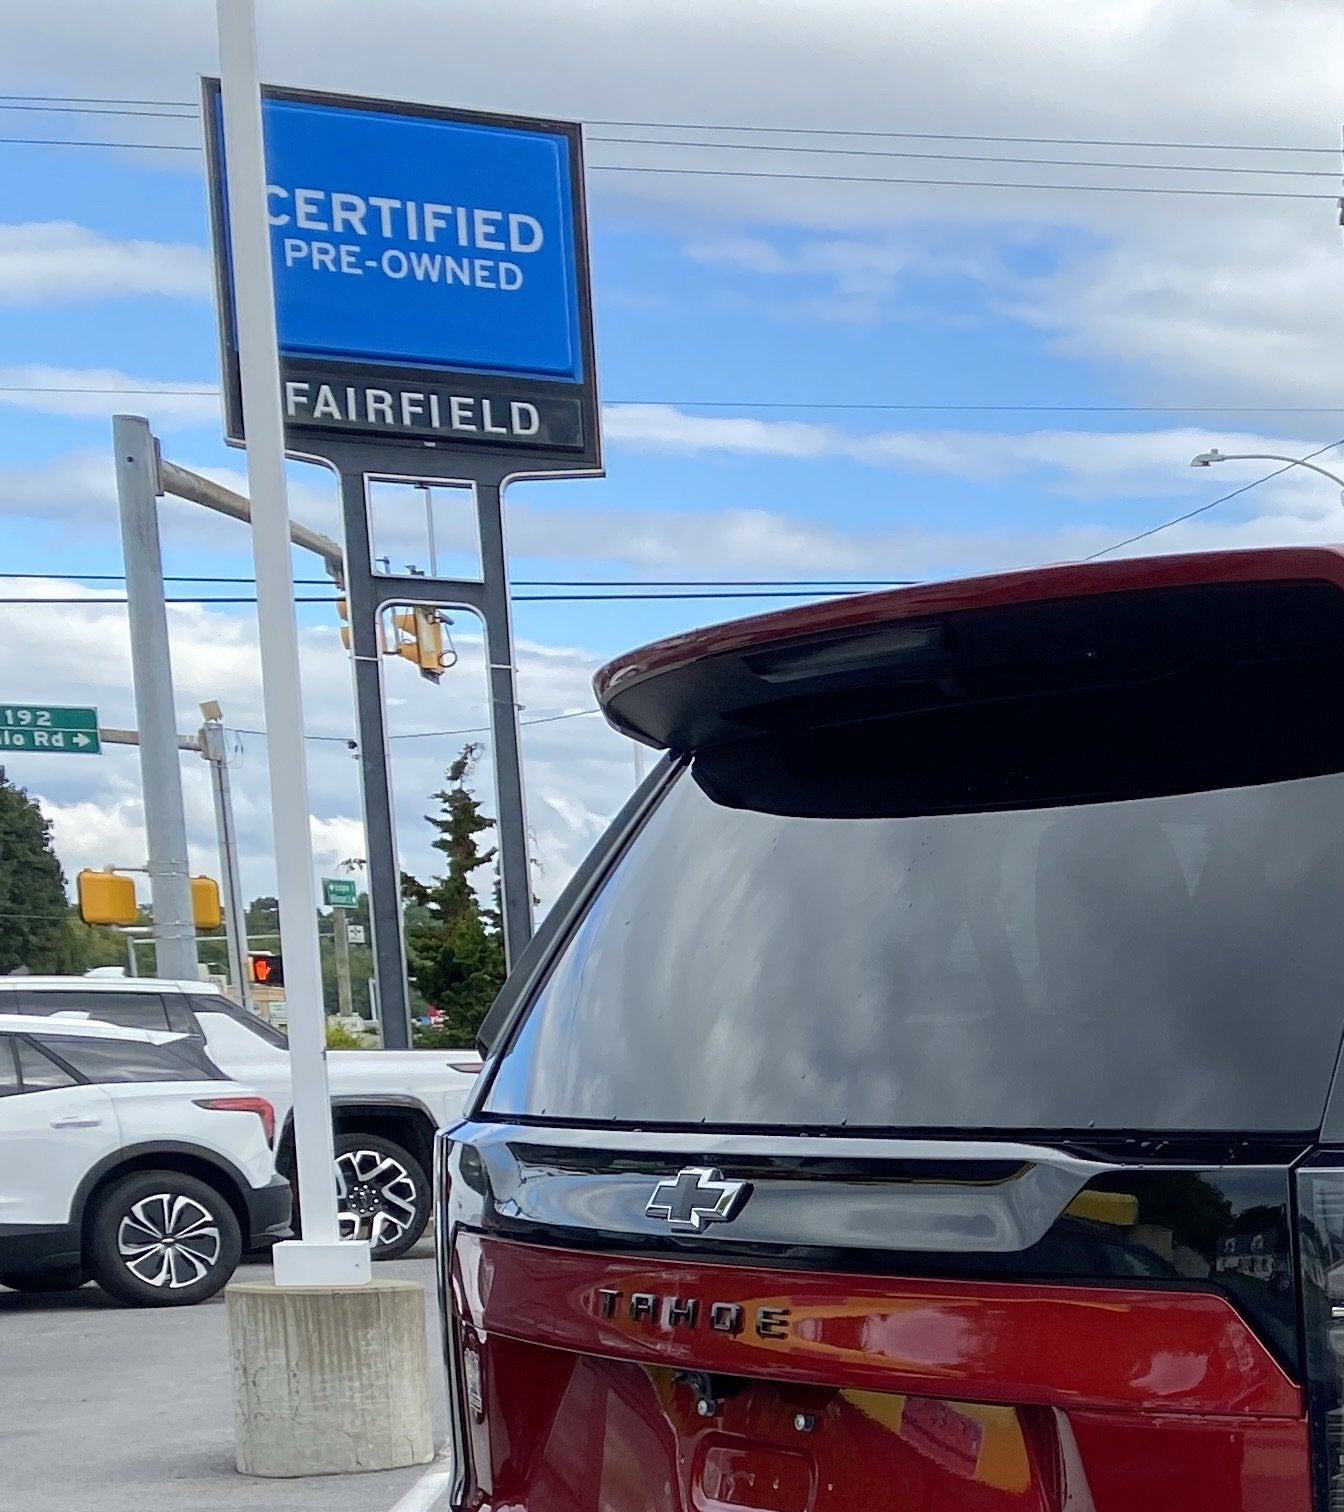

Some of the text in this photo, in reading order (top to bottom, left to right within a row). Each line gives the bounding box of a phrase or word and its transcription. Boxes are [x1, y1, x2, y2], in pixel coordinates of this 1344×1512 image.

[266, 184, 544, 254] CERTIFIED
[284, 238, 523, 291] PRE-OWNED
[286, 381, 540, 436] FAIRFIELD
[0, 730, 64, 747] lo Rd
[4, 709, 52, 726] 192
[596, 1288, 791, 1341] TAHOE
